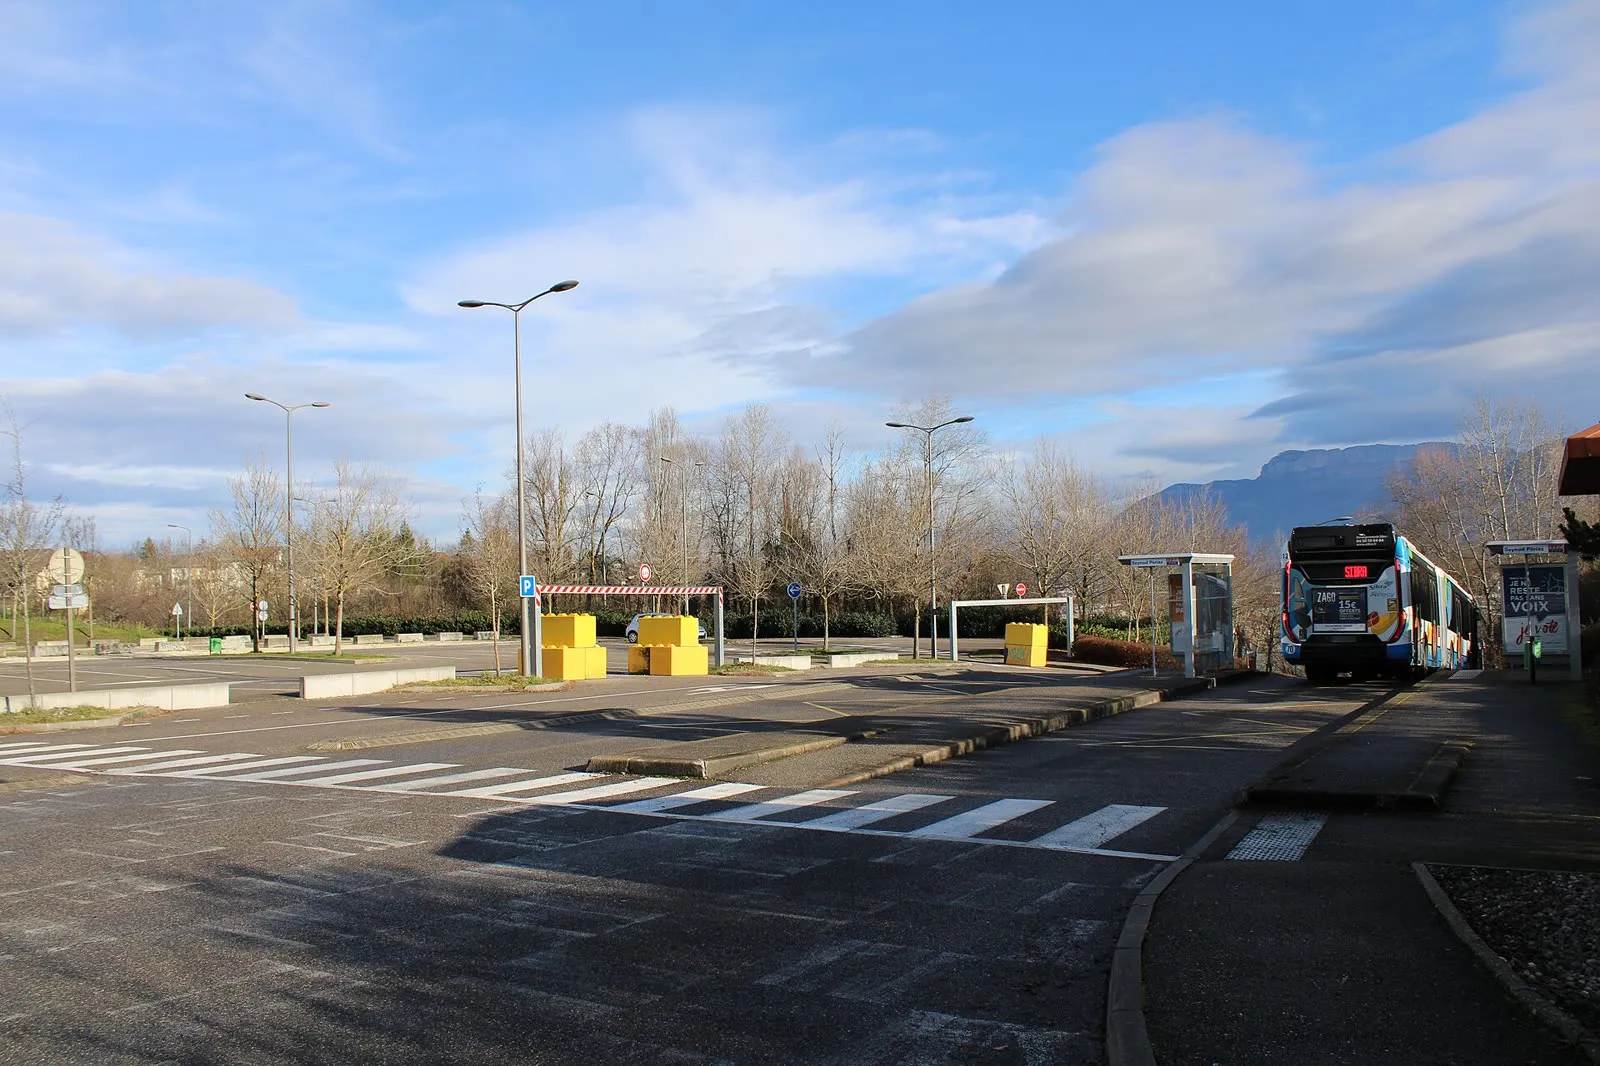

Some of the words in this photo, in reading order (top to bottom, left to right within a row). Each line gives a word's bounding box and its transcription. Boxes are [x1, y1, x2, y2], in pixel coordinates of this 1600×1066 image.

[1344, 566, 1368, 578] SIBRA
[524, 580, 531, 593] P
[1510, 587, 1541, 595] RESTE
[1338, 600, 1357, 609] 15€
[1510, 600, 1549, 613] VOIX
[1287, 645, 1294, 653] 70
